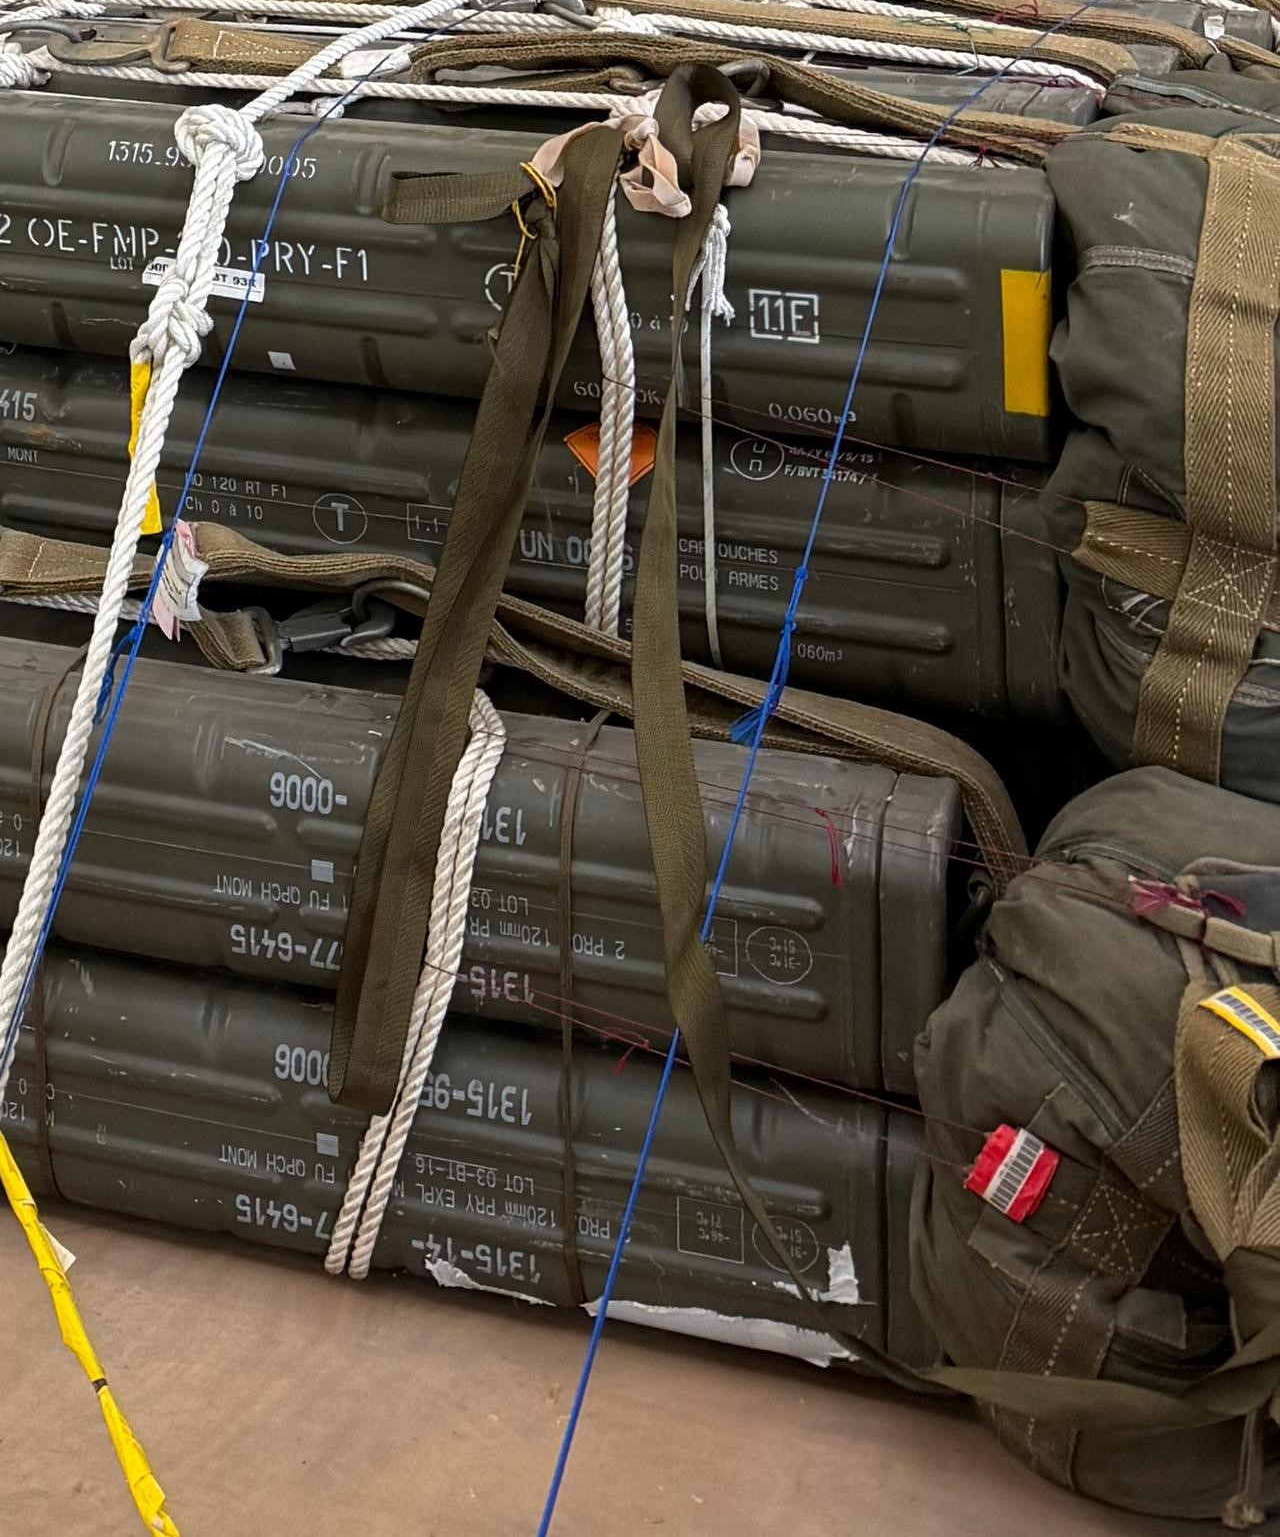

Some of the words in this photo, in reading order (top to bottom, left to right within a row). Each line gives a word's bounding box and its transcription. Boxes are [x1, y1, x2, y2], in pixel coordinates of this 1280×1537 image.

[110, 255, 135, 272] LOT
[7, 447, 40, 464] MONT
[211, 475, 237, 492] 120
[245, 480, 262, 496] RT
[271, 483, 288, 500] F1
[211, 500, 221, 515] 0
[228, 501, 237, 517] à
[246, 505, 263, 521] 10
[330, 502, 350, 531] T
[520, 529, 554, 561] UN
[728, 571, 780, 592] ARMES
[213, 873, 253, 897] MONT
[309, 890, 331, 912] FU
[498, 897, 529, 917] LOT
[231, 924, 344, 972] 77-6415
[499, 925, 552, 949] 120mm
[614, 940, 625, 960] 2
[274, 1043, 329, 1088] 006
[218, 1143, 258, 1169] MONT
[314, 1163, 336, 1184] FU
[415, 1154, 498, 1189] 03-BT-16
[416, 1183, 455, 1209] EXPL
[504, 1176, 535, 1196] LOT
[465, 1194, 496, 1217] PRY
[504, 1201, 557, 1228] 120mm
[575, 1215, 610, 1240] PRO
